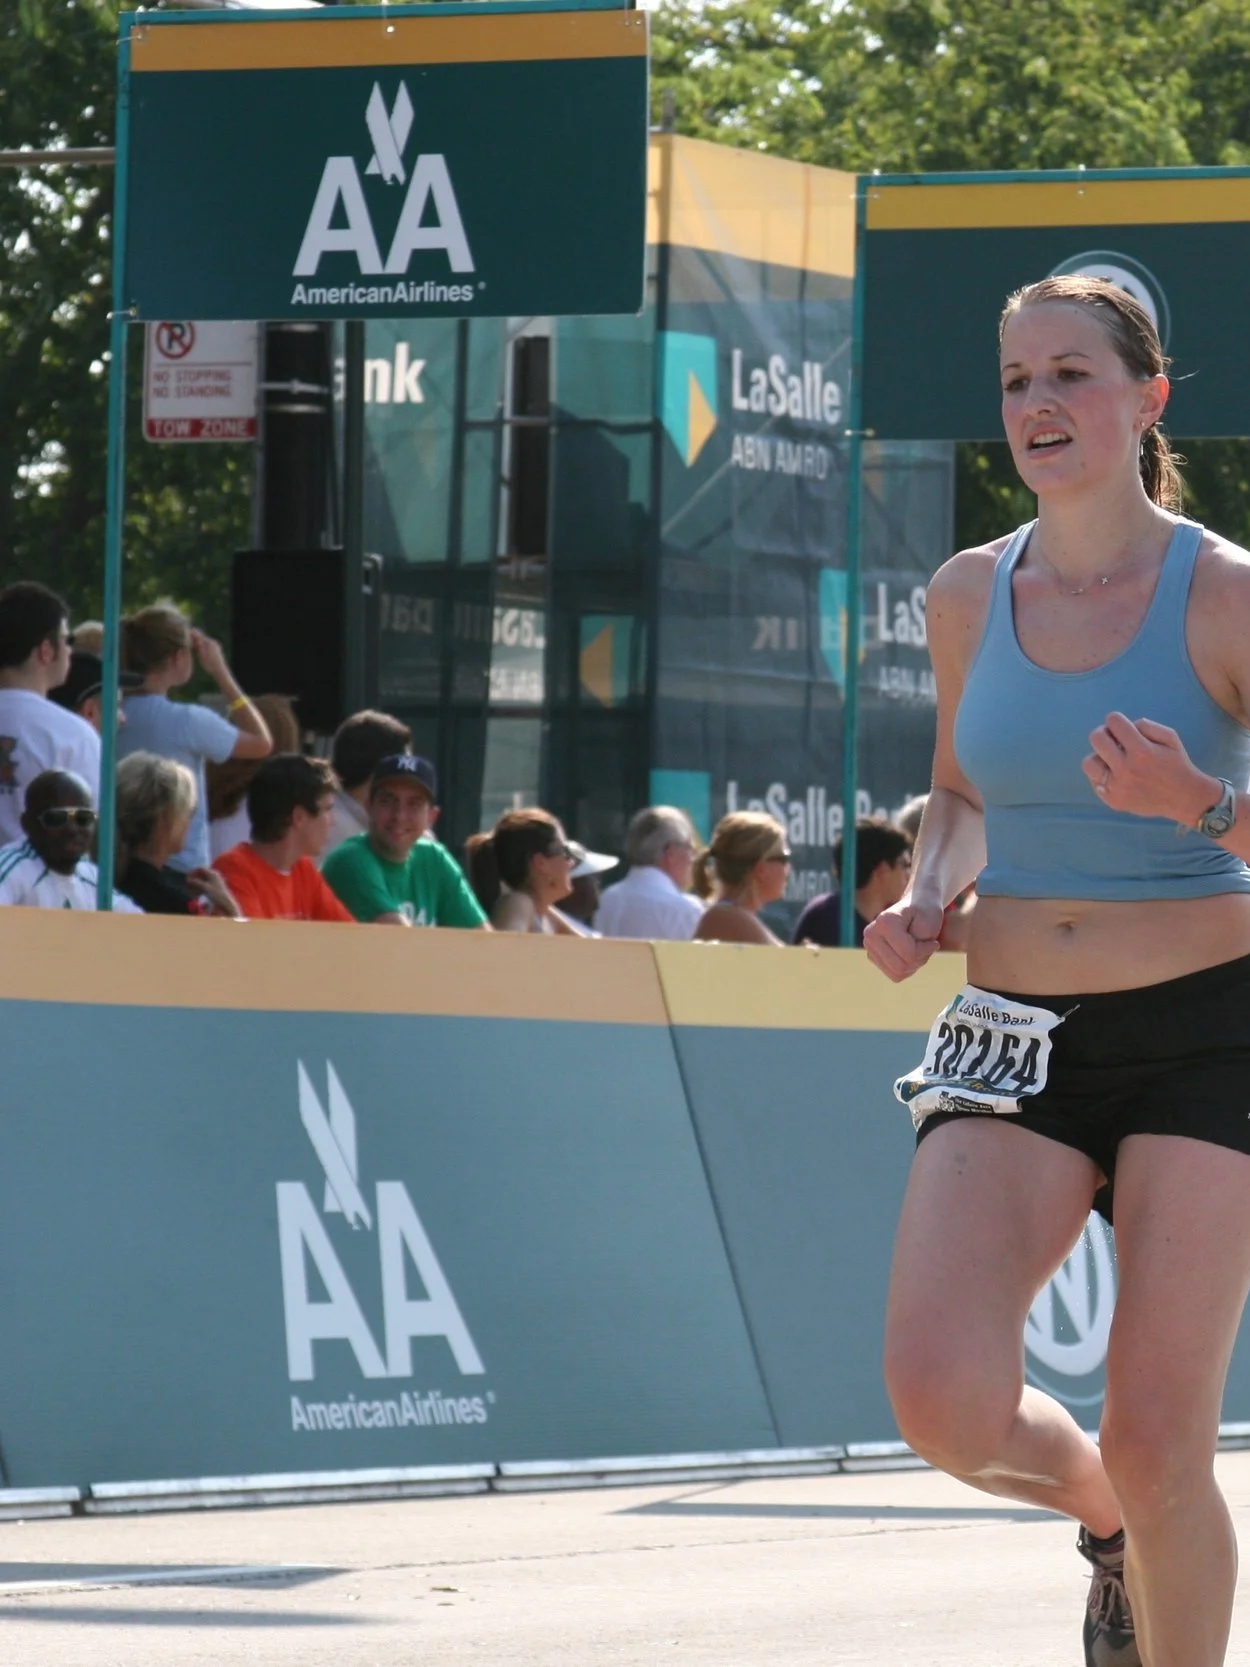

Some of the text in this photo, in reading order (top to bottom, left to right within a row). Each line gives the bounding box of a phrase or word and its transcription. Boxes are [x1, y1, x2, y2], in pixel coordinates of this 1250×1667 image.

[153, 371, 169, 383] NO
[731, 347, 842, 425] LaSalle
[153, 385, 169, 398] NO
[155, 419, 250, 438] TOW ZONE
[730, 433, 830, 481] ABN AMRO
[959, 1000, 1000, 1022] LaSalle
